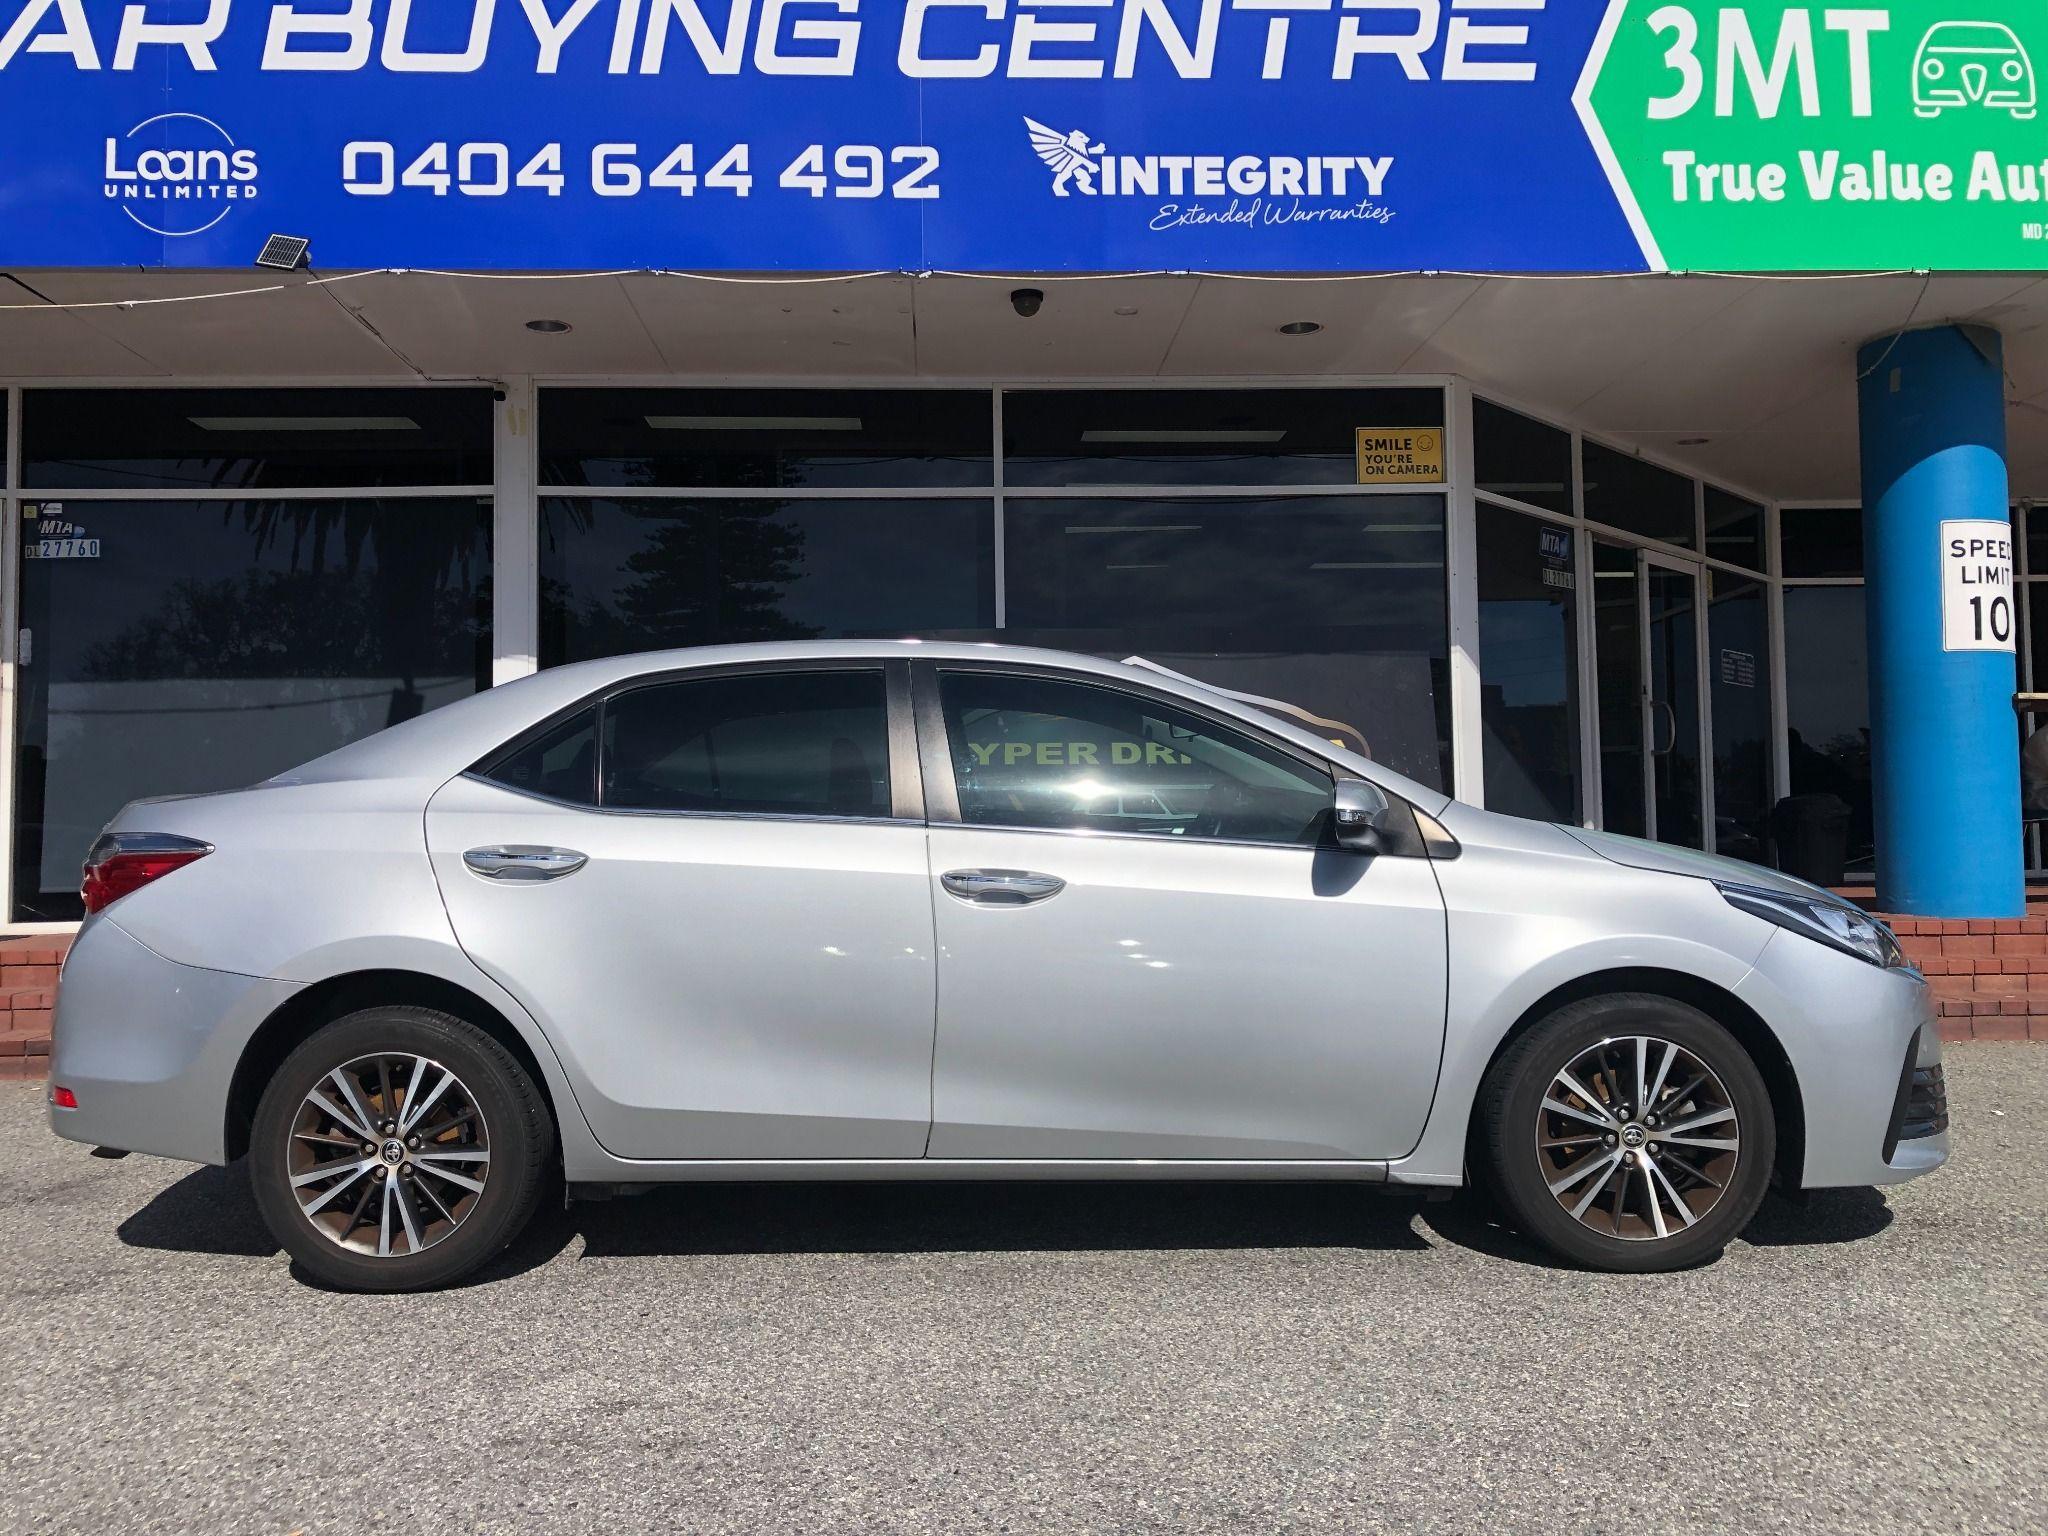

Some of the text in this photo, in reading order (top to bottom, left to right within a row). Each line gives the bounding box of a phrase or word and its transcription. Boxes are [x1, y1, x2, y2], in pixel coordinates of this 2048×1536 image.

[261, 0, 861, 76] BUYING
[898, 0, 1545, 80] CENTRE
[1647, 5, 1890, 119] 3MT
[105, 137, 258, 181] Loans
[343, 141, 940, 198] 0404 644 492
[1101, 155, 1395, 196] INTEGRITY
[1663, 150, 1786, 202] True
[1798, 150, 1952, 202] Value
[104, 184, 258, 199] UNLIMITED
[1149, 198, 1396, 231] Extended Warranties
[1364, 438, 1413, 451] SMILE
[1365, 454, 1413, 464] YOU'RE
[1365, 464, 1439, 475] ON CAMERA
[40, 520, 73, 534] MTA
[42, 541, 98, 556] 27760
[1541, 533, 1560, 553] MTA
[1961, 565, 2010, 587] LIMIT
[1969, 595, 2010, 642] 10
